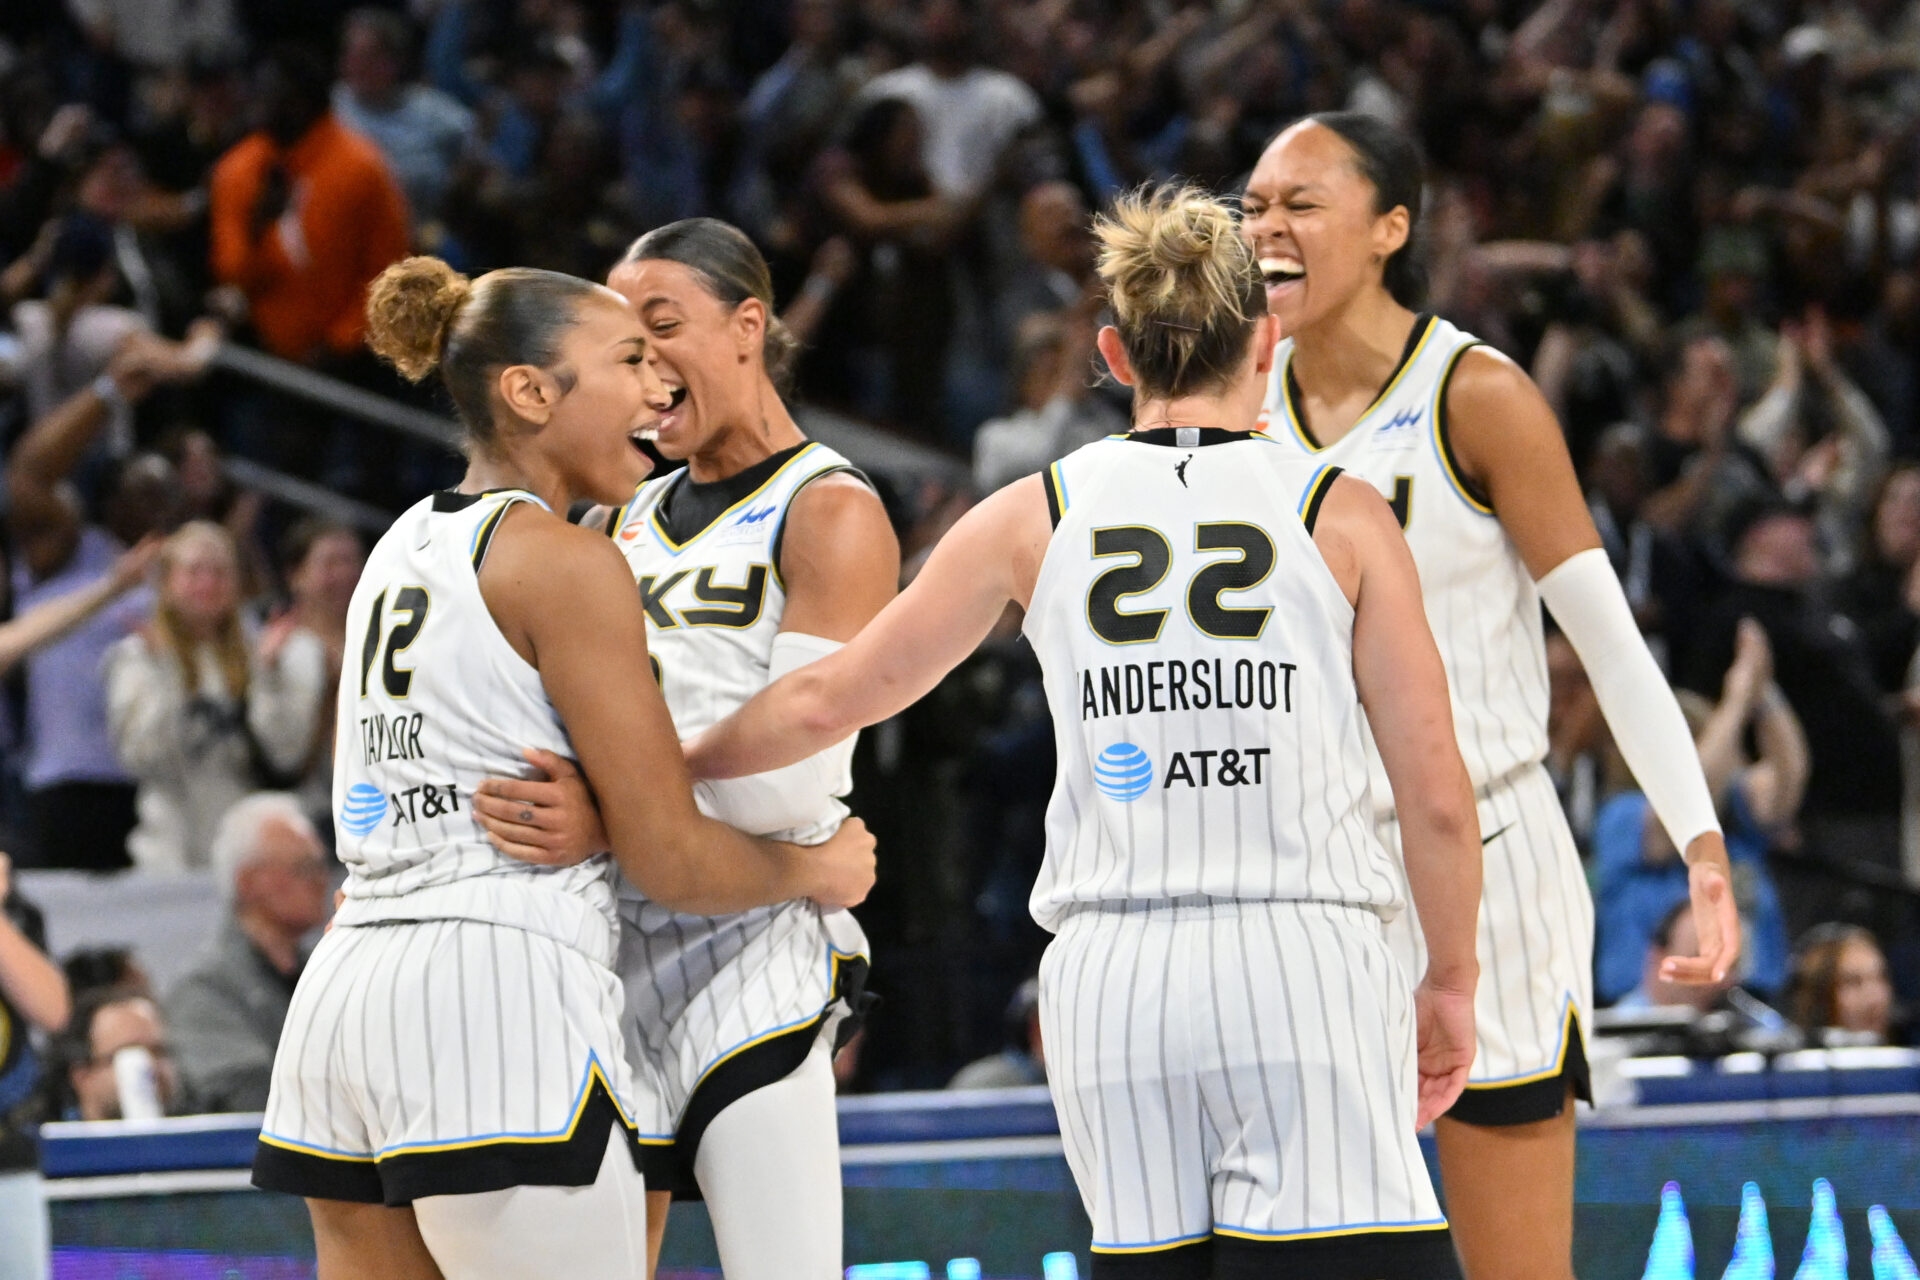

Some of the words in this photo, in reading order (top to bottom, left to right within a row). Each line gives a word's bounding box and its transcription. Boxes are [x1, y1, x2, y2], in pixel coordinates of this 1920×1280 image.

[637, 562, 770, 632] KY
[1085, 520, 1277, 646] 22
[360, 583, 431, 699] 12
[1077, 658, 1297, 721] ANDERSLOOT
[361, 712, 425, 767] TAYLOR
[1163, 747, 1271, 789] AT&T
[391, 783, 460, 827] AT&T
